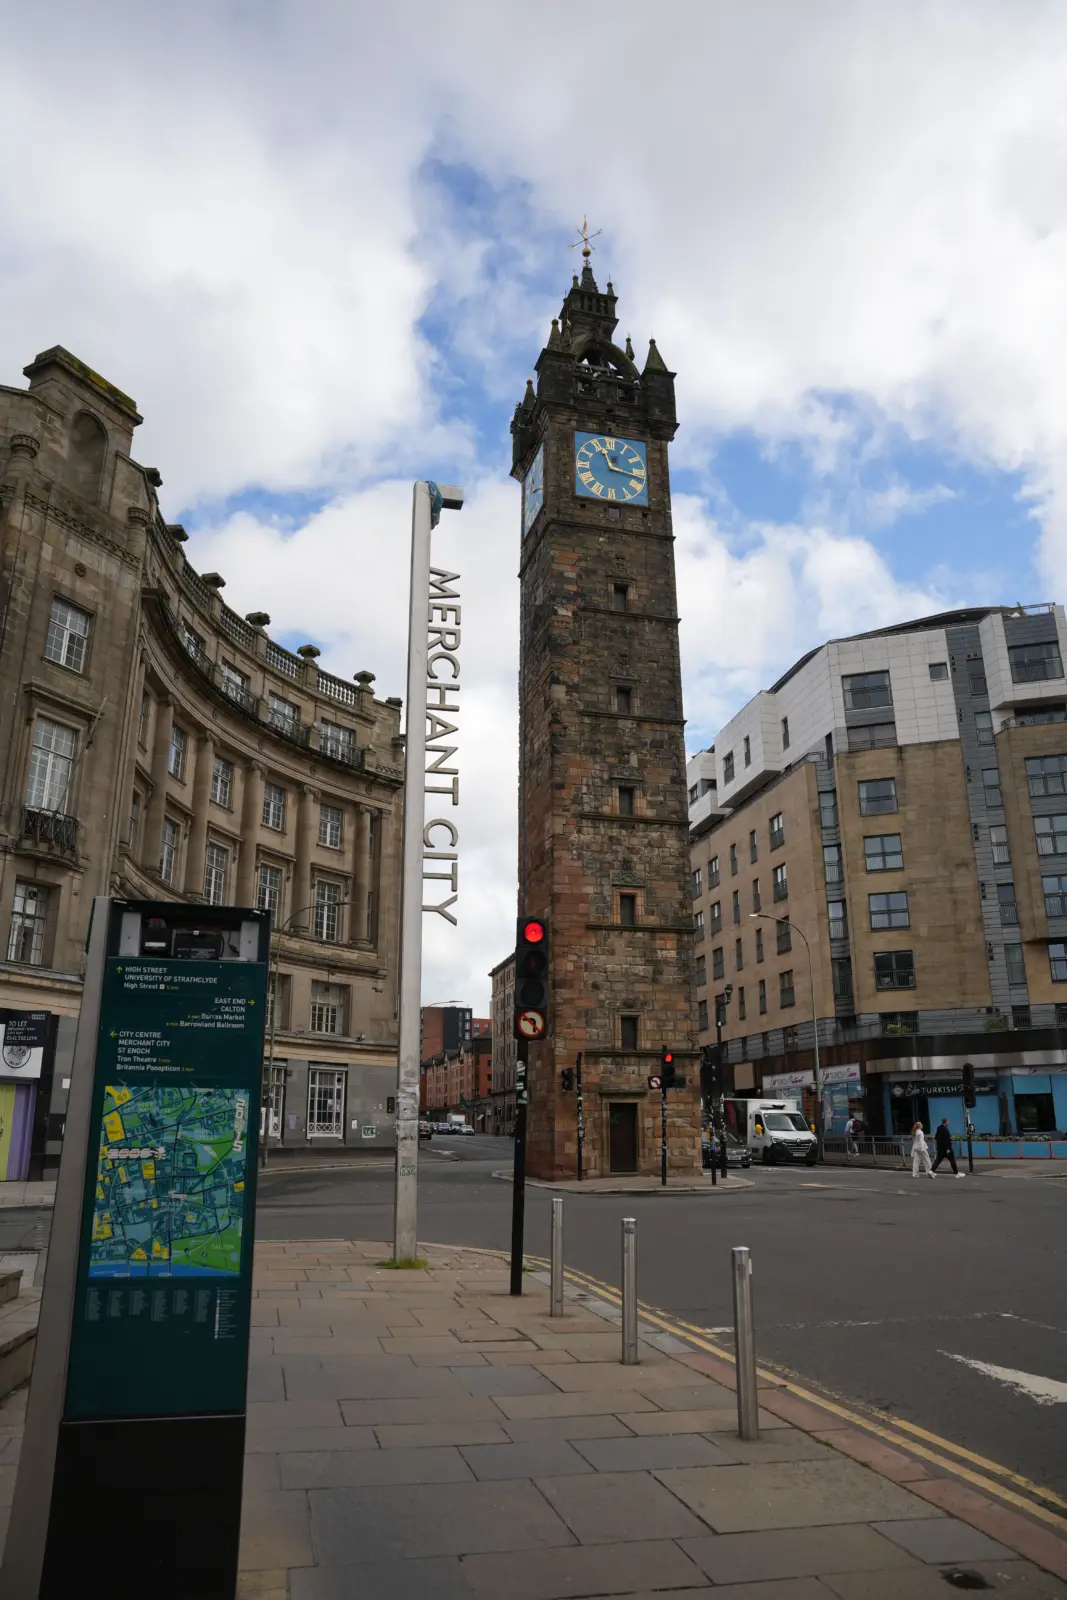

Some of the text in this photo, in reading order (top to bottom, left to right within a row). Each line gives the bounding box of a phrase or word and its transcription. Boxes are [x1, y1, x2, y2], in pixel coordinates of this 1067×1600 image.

[422, 567, 461, 927] MERCHANT CITY
[124, 974, 162, 982] UNIVERSITY
[173, 976, 218, 984] STRATHCLYDE
[123, 982, 138, 990] High
[132, 1055, 157, 1063] Theatre
[146, 1064, 181, 1072] Panopticon
[922, 1085, 957, 1094] TURKISH
